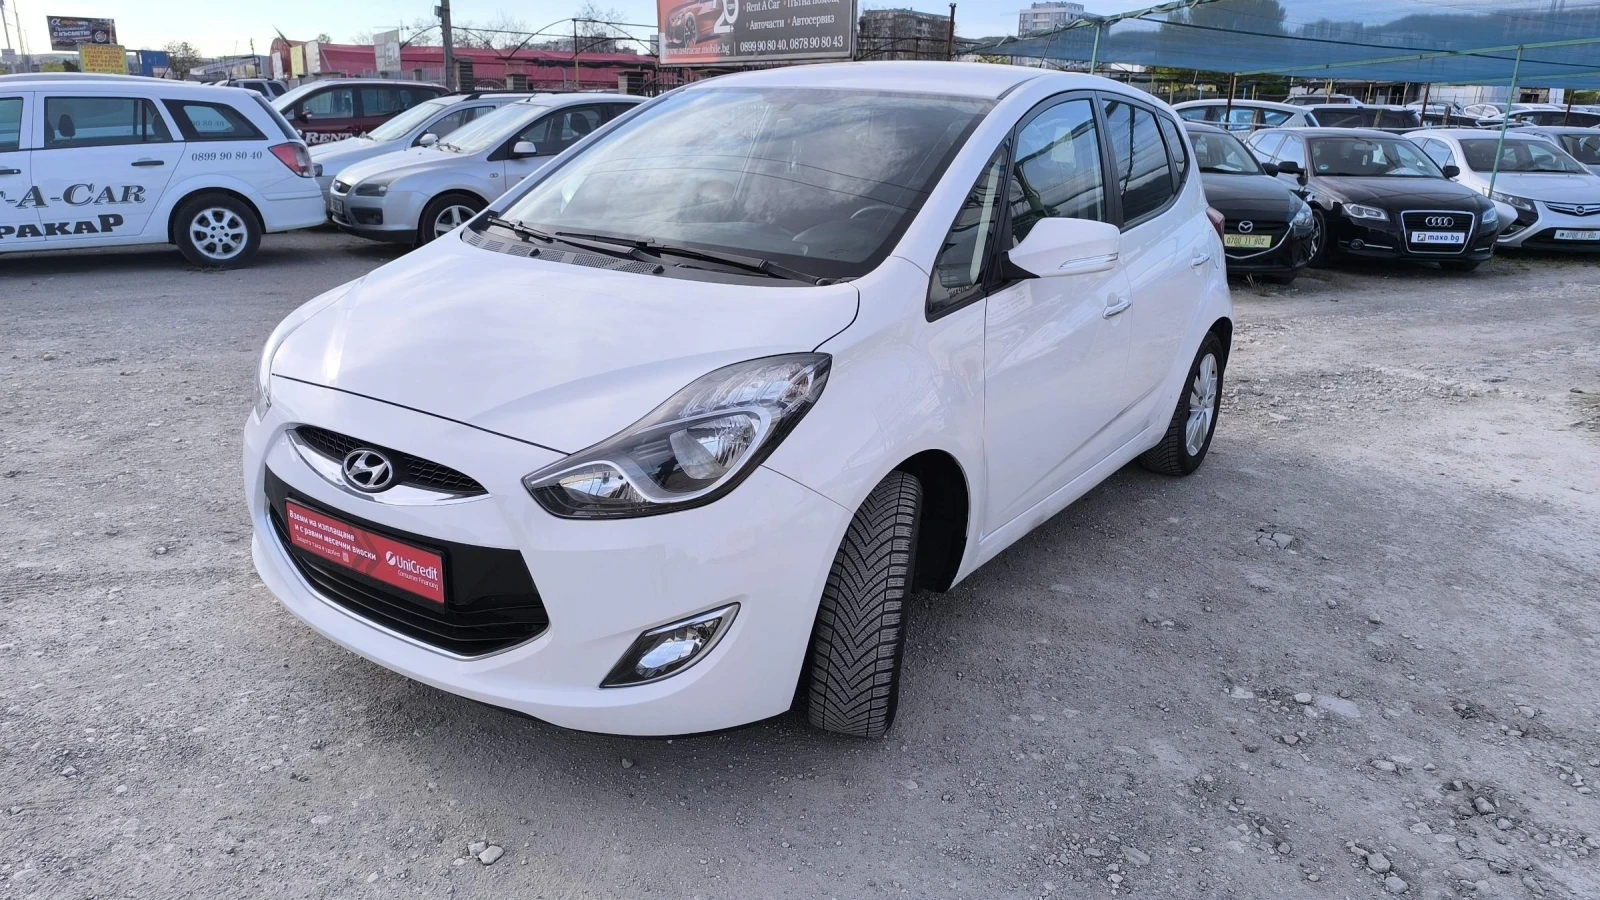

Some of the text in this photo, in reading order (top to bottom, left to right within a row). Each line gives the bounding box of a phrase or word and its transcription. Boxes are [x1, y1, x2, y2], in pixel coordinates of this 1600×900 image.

[746, 0, 780, 13] Rent A Car
[749, 15, 835, 30] Авточасти Автосервиз
[739, 41, 757, 52] 0899
[757, 40, 767, 51] 90
[767, 39, 776, 51] 80
[789, 37, 809, 49] 0878
[809, 37, 820, 48] 90
[820, 36, 832, 48] 80
[832, 35, 844, 47] 43
[191, 150, 263, 162] 0899 90 80 40
[1427, 234, 1460, 243] maxo.bg
[289, 509, 355, 542] Вземи на изплащане
[294, 523, 300, 531] и
[304, 527, 324, 541] равни
[323, 536, 352, 552] месечни
[352, 545, 377, 561] вноски
[396, 555, 438, 581] UniCredit
[397, 569, 418, 583] Consumer
